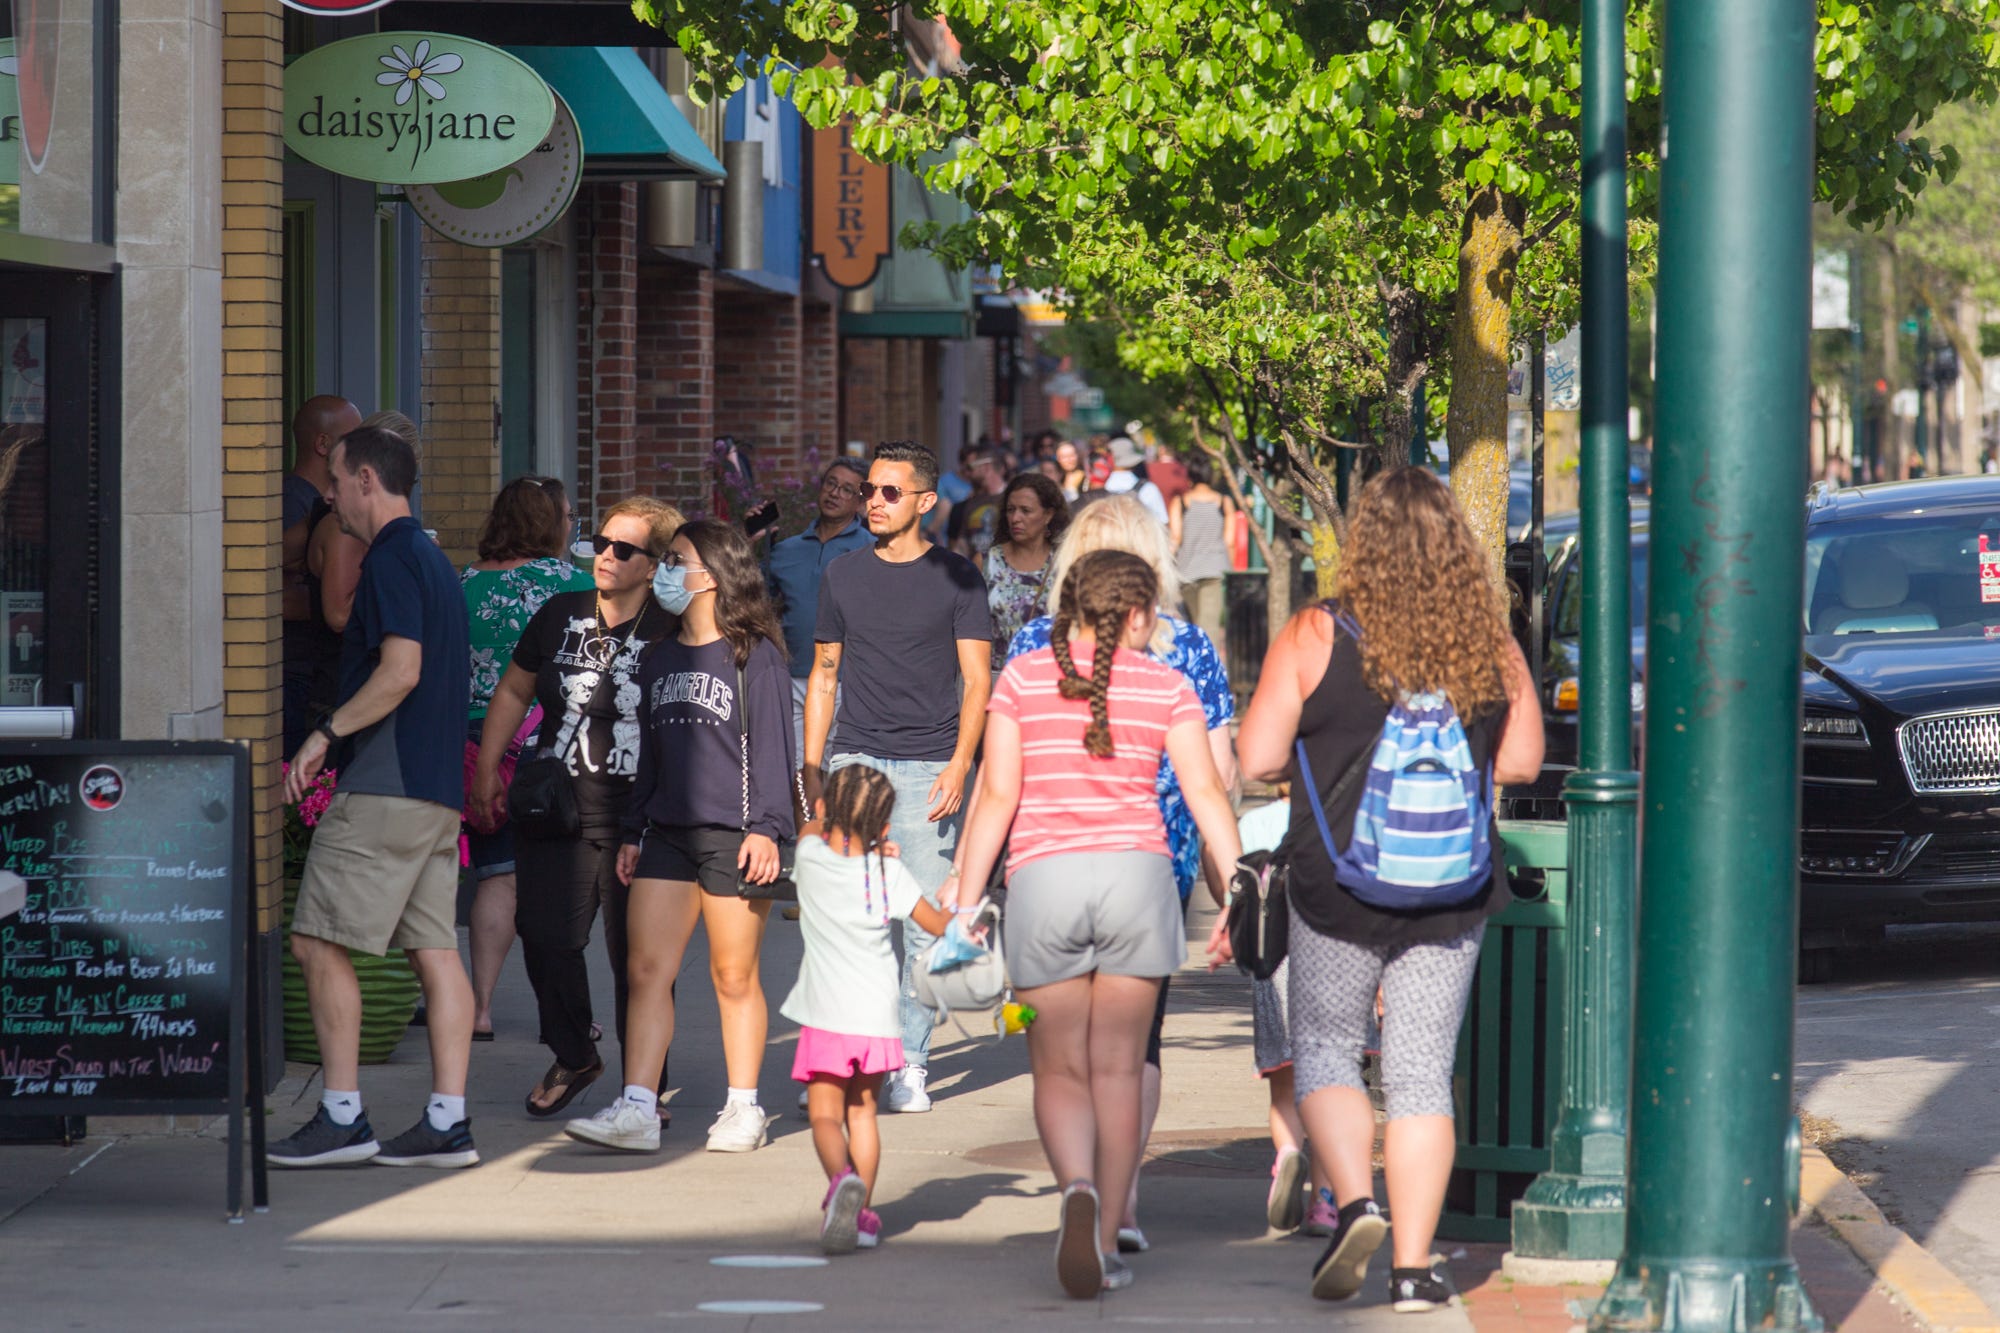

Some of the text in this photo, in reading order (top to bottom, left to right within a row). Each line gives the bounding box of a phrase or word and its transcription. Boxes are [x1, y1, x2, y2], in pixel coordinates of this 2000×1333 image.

[298, 95, 516, 153] daisy jane
[660, 672, 733, 721] ANGELES
[2, 822, 46, 854] VOTED
[52, 820, 88, 855] BES
[1, 926, 43, 955] BEST
[50, 925, 94, 956] RIBS
[1, 985, 47, 1012] BEST
